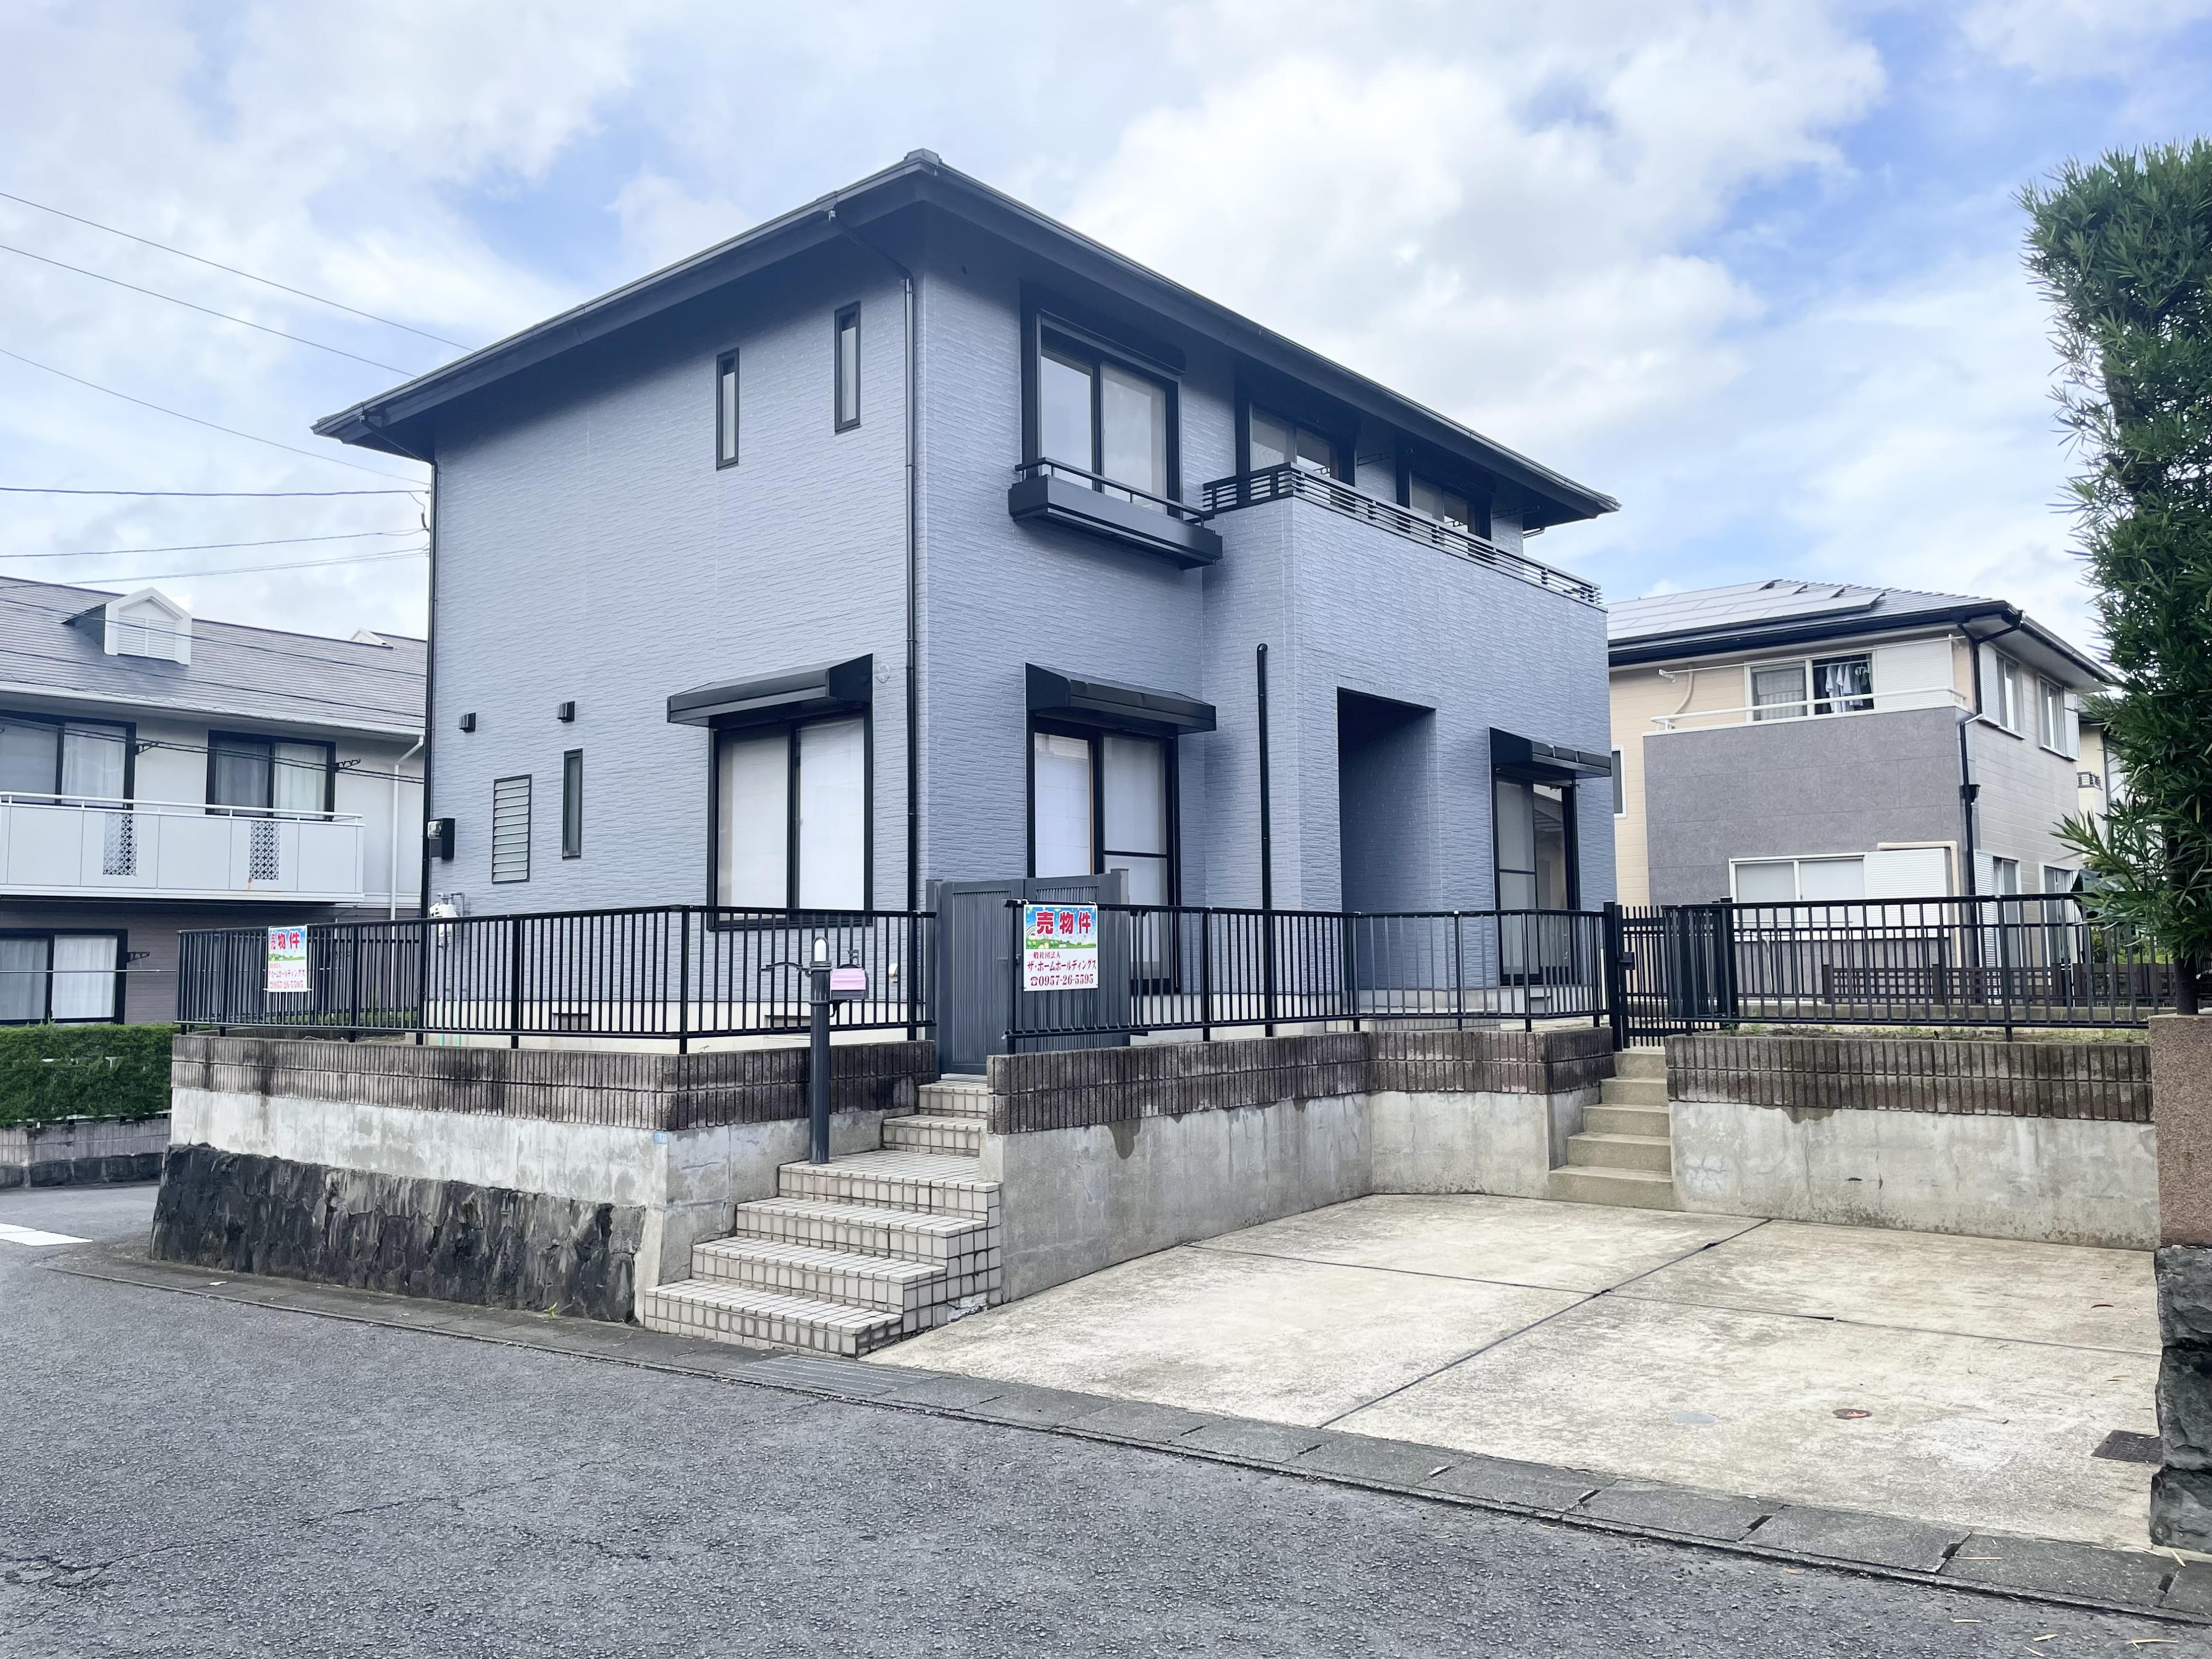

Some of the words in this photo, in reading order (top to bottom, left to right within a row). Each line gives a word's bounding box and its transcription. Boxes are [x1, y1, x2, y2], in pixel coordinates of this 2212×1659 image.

[1037, 911, 1091, 934] 売物件
[270, 932, 300, 950] 売物件
[1039, 974, 1093, 987] 0957-26-5595
